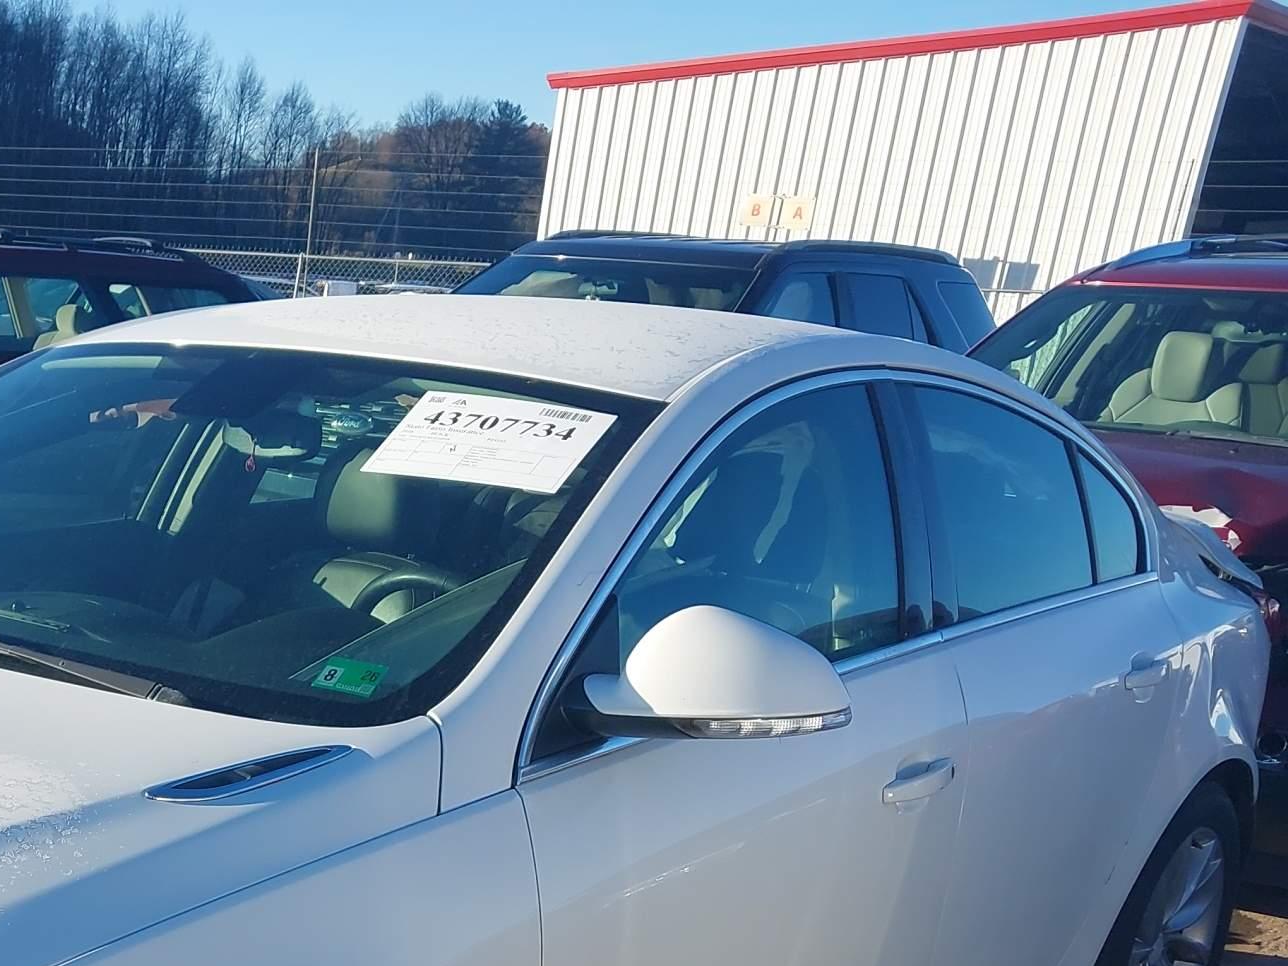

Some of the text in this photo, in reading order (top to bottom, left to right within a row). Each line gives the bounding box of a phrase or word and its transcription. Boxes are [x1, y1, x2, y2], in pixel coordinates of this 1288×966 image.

[751, 203, 761, 217] B
[792, 206, 802, 220] A
[423, 410, 577, 441] 43707734
[324, 668, 338, 682] 8
[360, 670, 379, 682] 26
